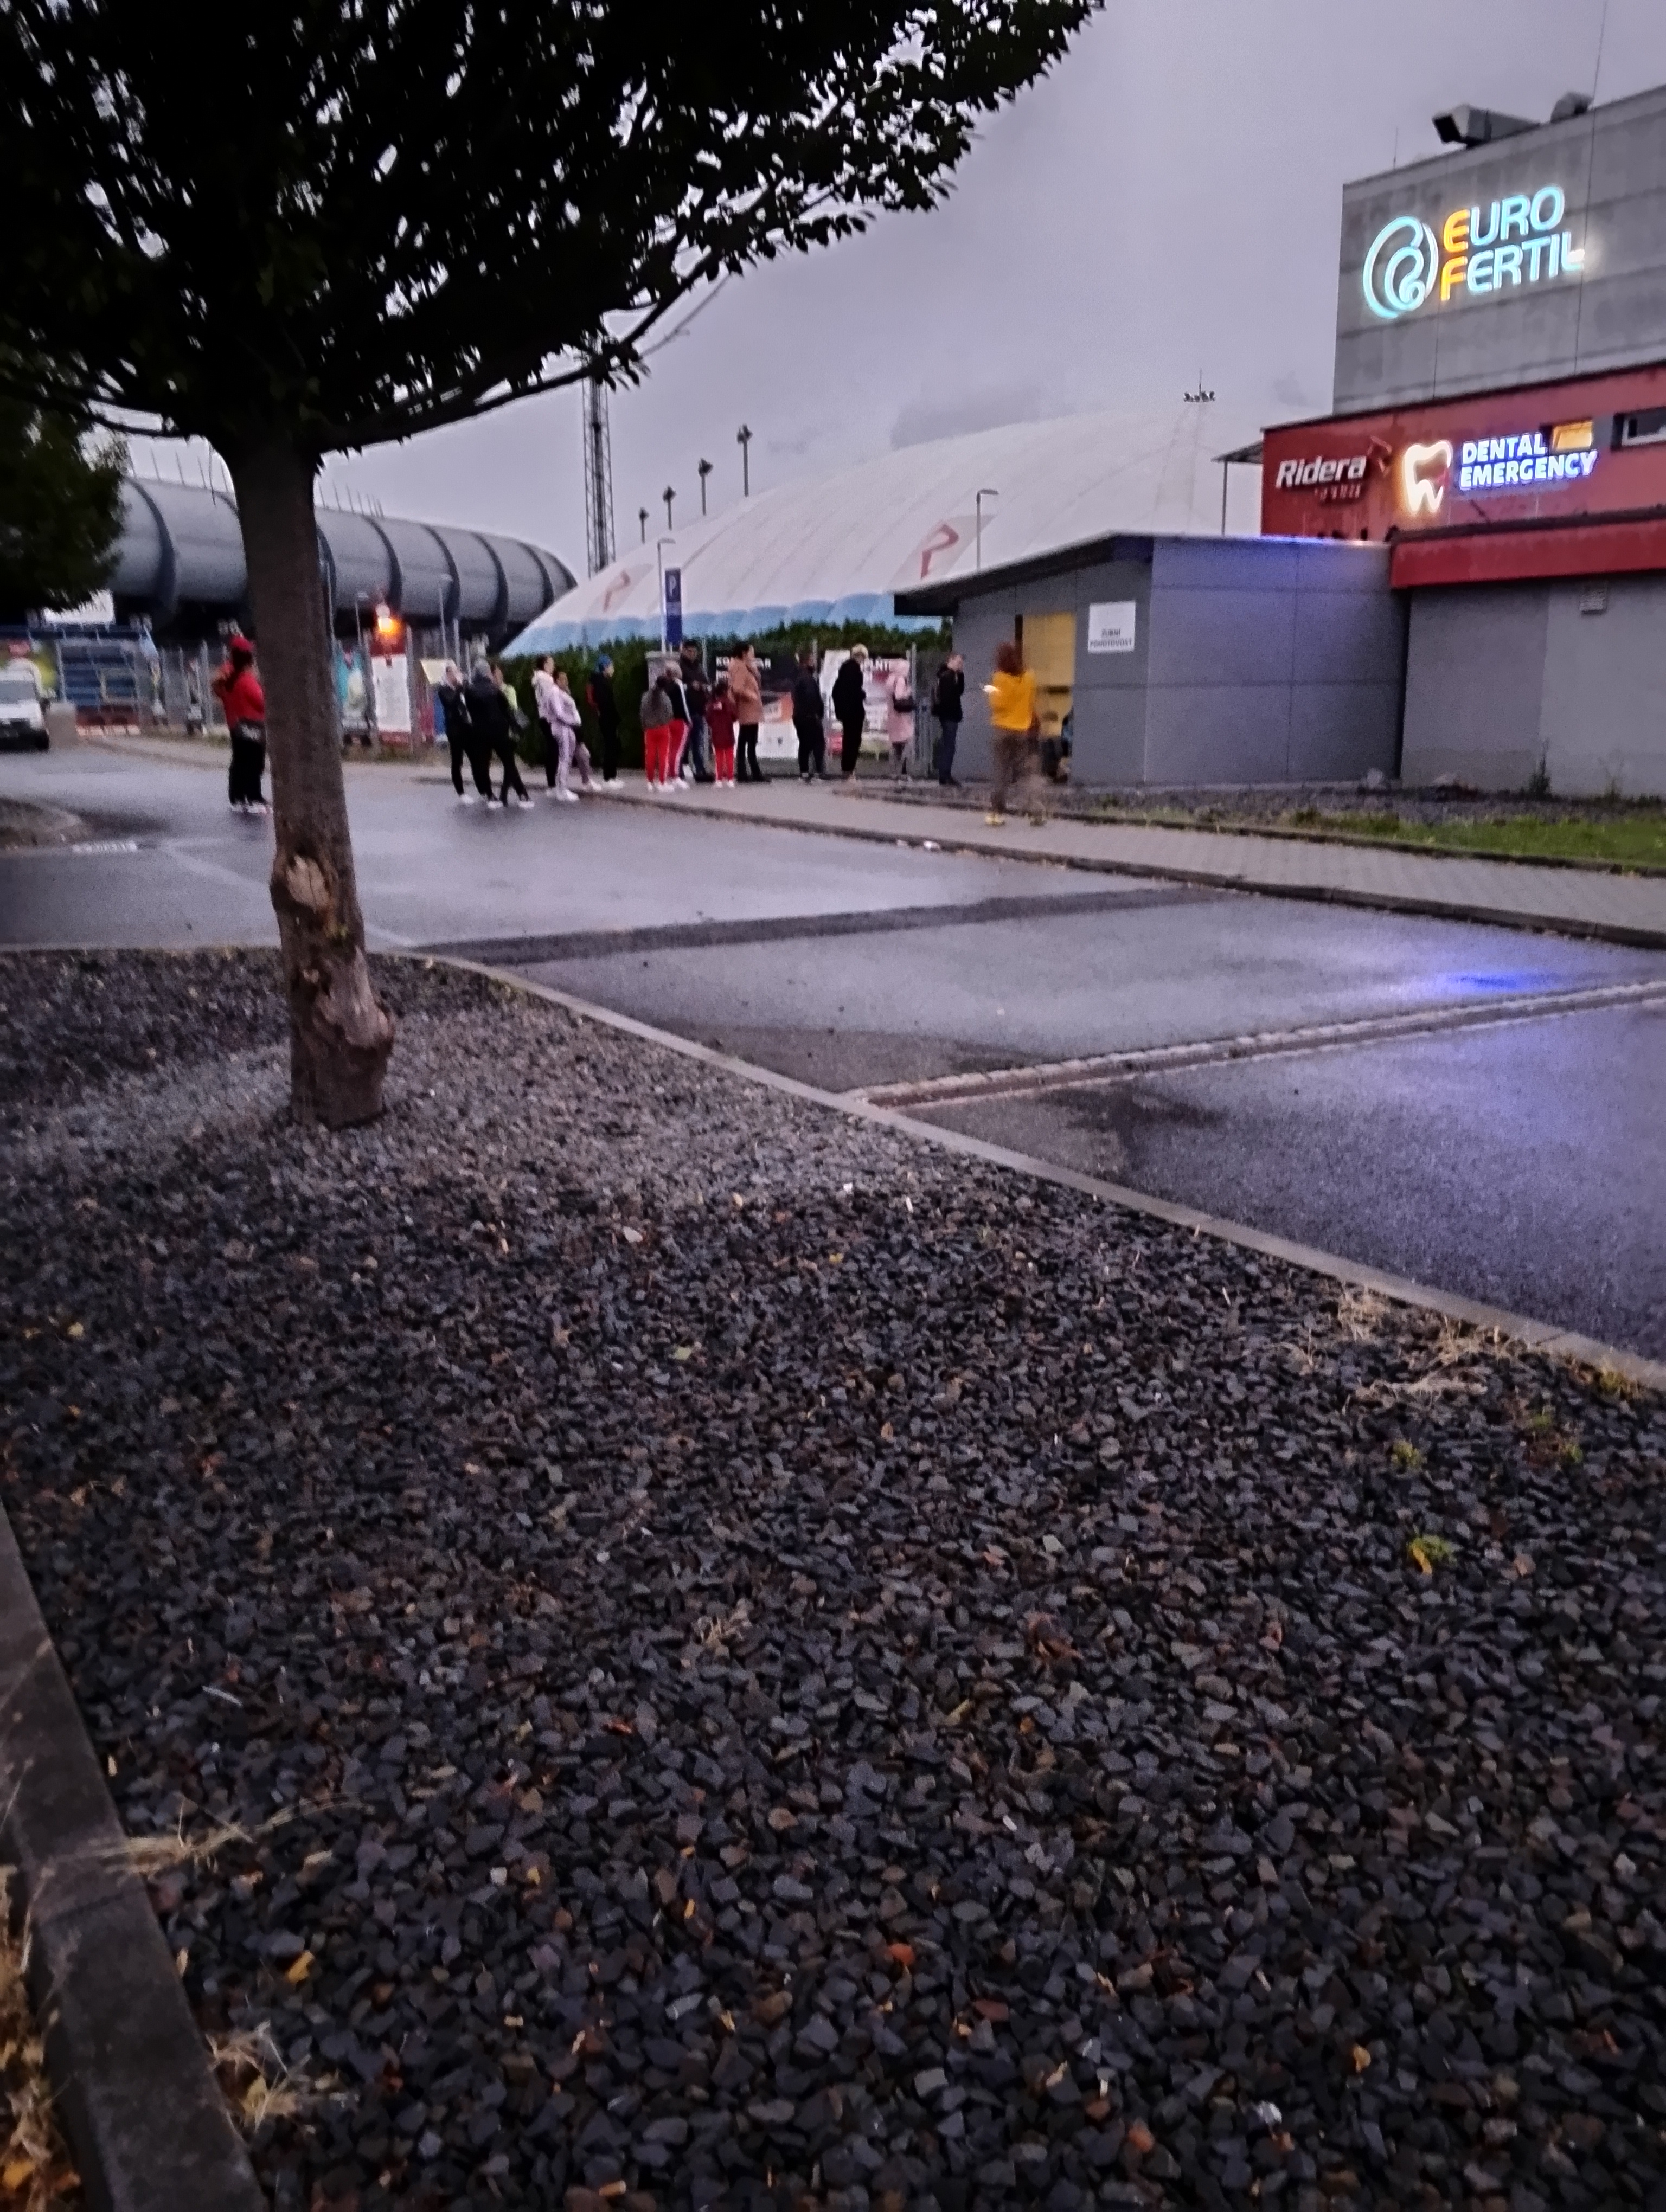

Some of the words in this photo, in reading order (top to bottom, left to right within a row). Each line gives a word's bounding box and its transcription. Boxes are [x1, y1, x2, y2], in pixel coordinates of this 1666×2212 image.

[1443, 184, 1565, 253] EURO
[1440, 231, 1584, 301] FERTIL
[1462, 432, 1547, 465] DENTAL
[1276, 455, 1367, 489] Ridera
[1460, 449, 1597, 490] EMERGENCY
[668, 575, 676, 597] P
